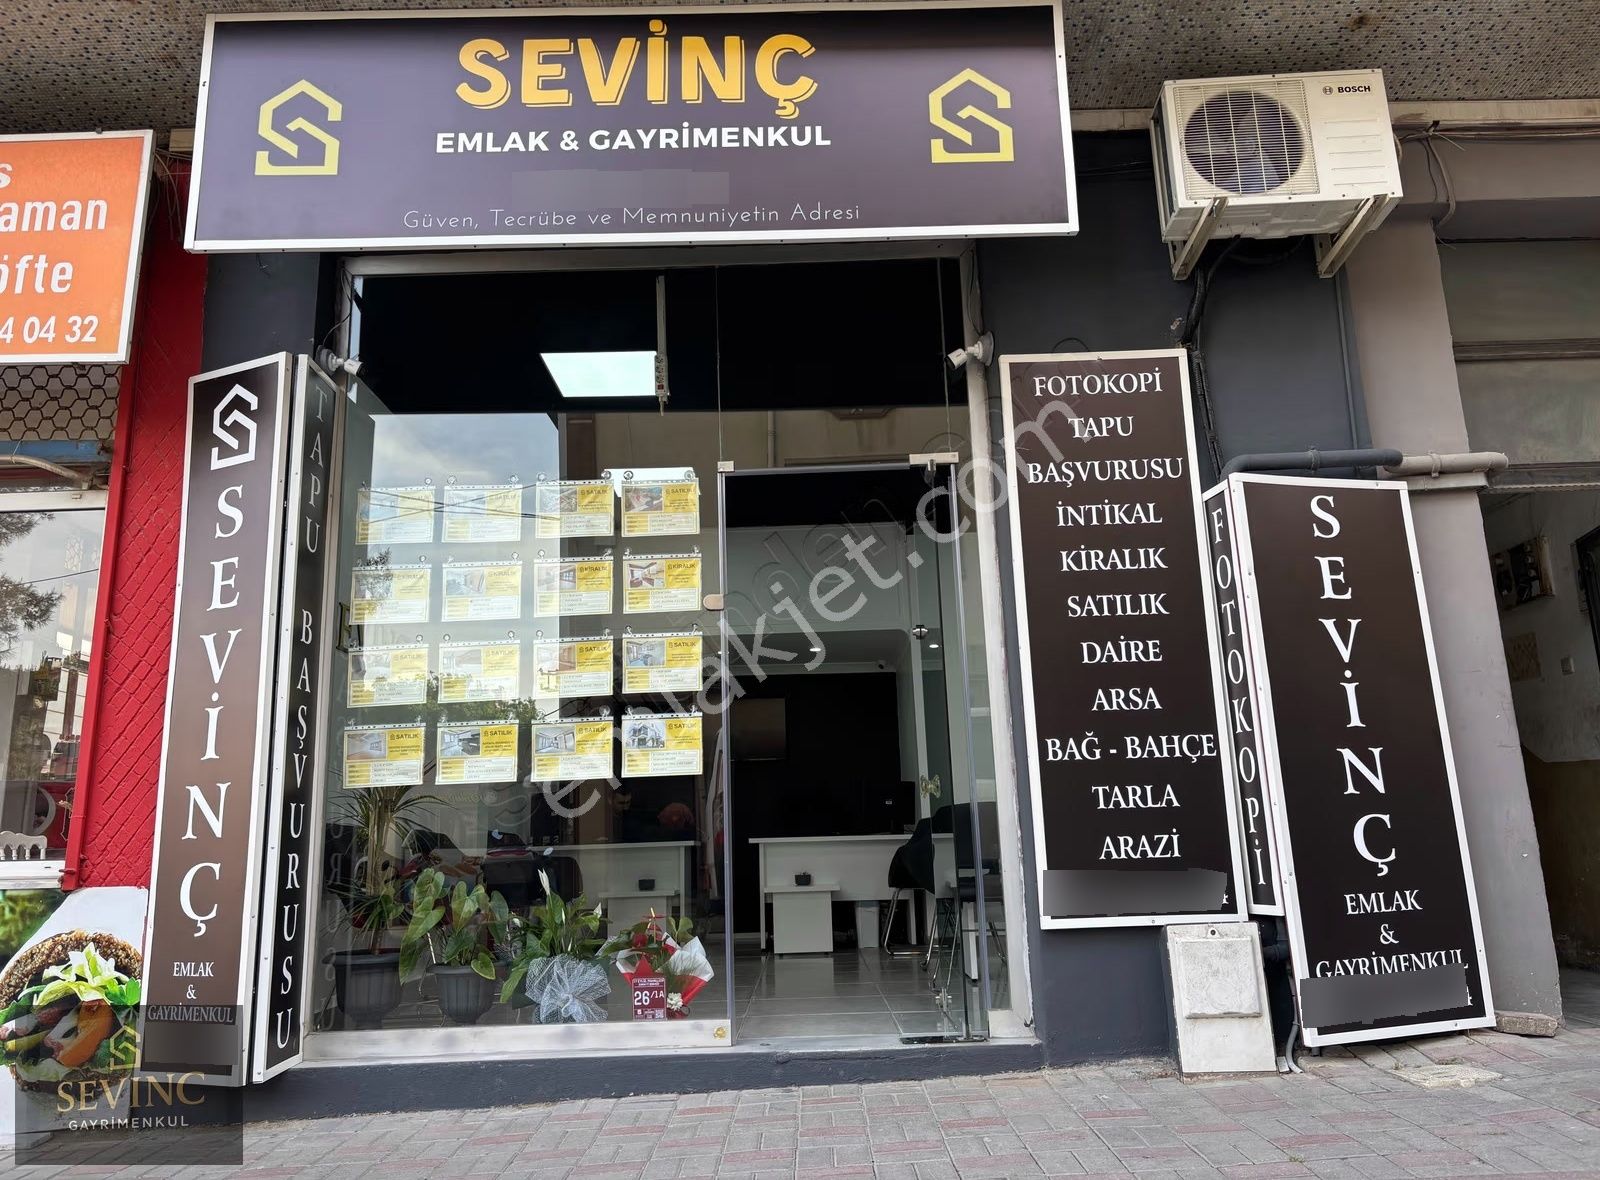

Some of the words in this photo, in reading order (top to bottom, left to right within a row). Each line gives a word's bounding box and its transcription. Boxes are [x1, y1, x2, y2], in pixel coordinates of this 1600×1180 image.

[456, 19, 819, 119] SEVİNÇ
[1337, 85, 1371, 94] BOSCH
[435, 131, 548, 154] EMLAK
[559, 131, 579, 152] &
[589, 120, 831, 151] GAYRİMENKUL
[403, 209, 479, 231] Güven,
[489, 207, 577, 228] Tecrübe
[587, 211, 613, 225] ve
[622, 203, 779, 228] Memnuniyetin
[790, 201, 861, 222] Adresi
[22, 315, 56, 344] 04
[65, 315, 99, 343] 32
[1033, 367, 1163, 397] FOTOKOPİ
[1068, 416, 1134, 439] TAPU
[304, 386, 328, 553] TAPU
[1027, 457, 1183, 488] BAŞVURUSU
[1056, 499, 1163, 527] İNTİKAL
[1060, 544, 1168, 572] KİRALIK
[1067, 593, 1170, 618] SATILIK
[1080, 635, 1163, 664] DAİRE
[1091, 687, 1163, 711] ARSA
[1211, 508, 1267, 885] FOTOKOPİ
[1309, 494, 1397, 877] SEVİNÇ
[178, 484, 245, 937] SEVİNÇ
[395, 731, 419, 740] SATILIK
[489, 728, 513, 737] SATILIK
[1045, 731, 1101, 761] BAĞ
[1123, 734, 1217, 764] BAHÇE
[1091, 783, 1180, 809] TARLA
[276, 608, 314, 1049] BAŞVURUSU
[1099, 828, 1181, 860] ARAZİ
[1343, 889, 1423, 915] EMLAK
[1379, 924, 1399, 944] &
[172, 962, 215, 977] EMLAK
[186, 985, 197, 1000] &
[147, 1002, 234, 1023] GAYRİMENKUL
